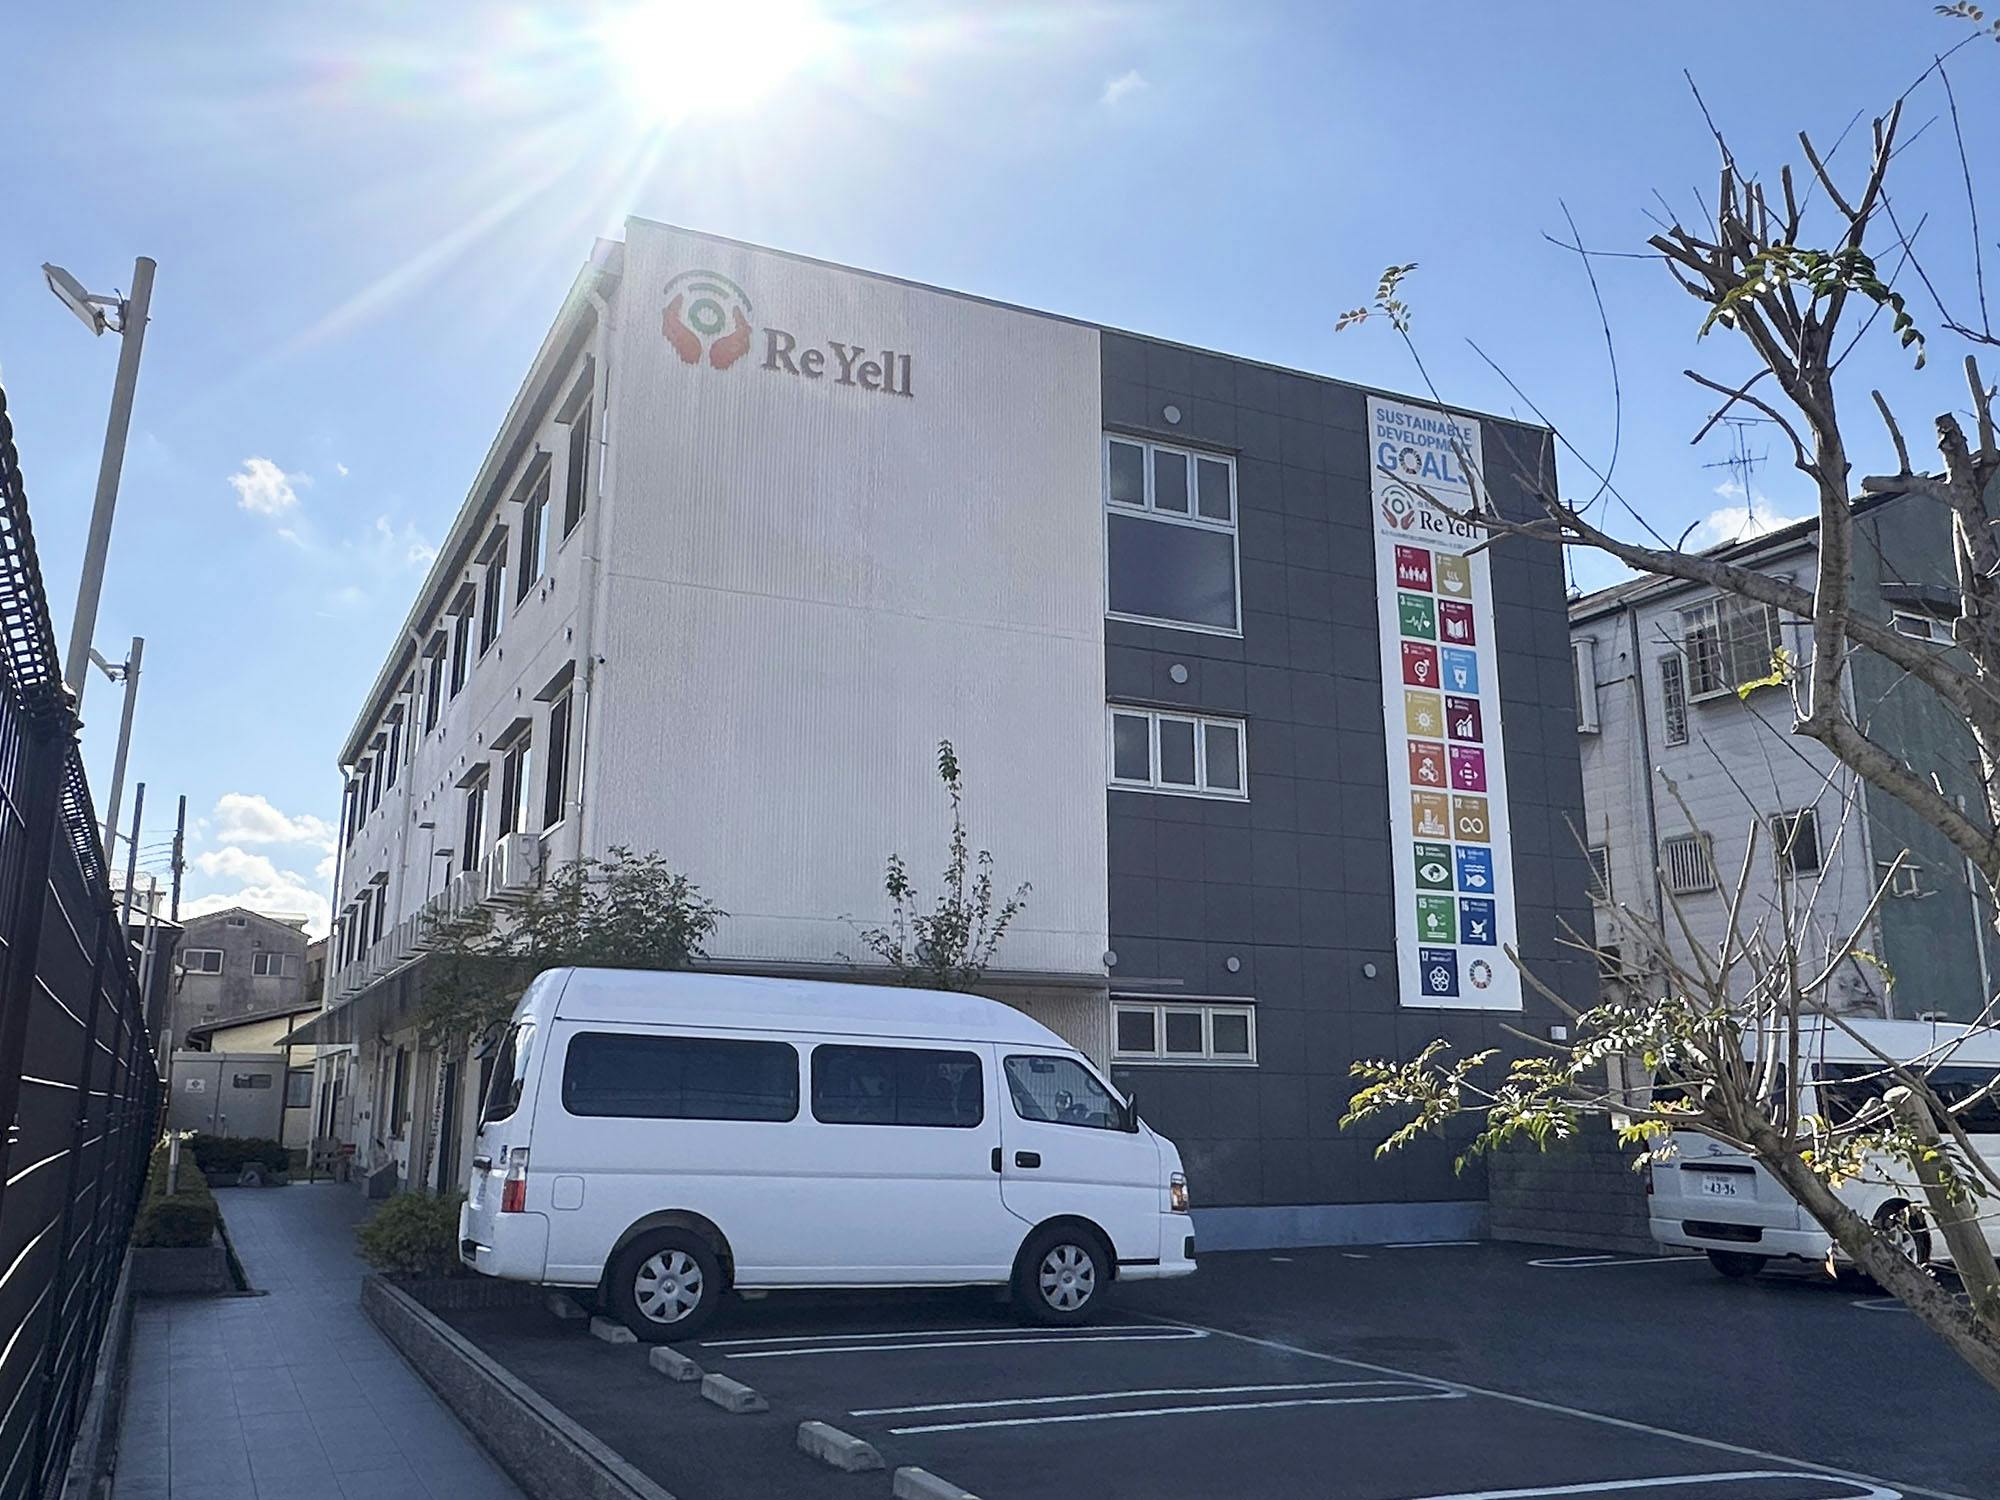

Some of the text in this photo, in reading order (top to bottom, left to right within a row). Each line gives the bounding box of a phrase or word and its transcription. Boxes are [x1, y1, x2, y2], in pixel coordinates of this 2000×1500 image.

[1377, 424, 1472, 455] DEVELOPM
[1403, 644, 1409, 655] 5
[1415, 845, 1424, 857] 13
